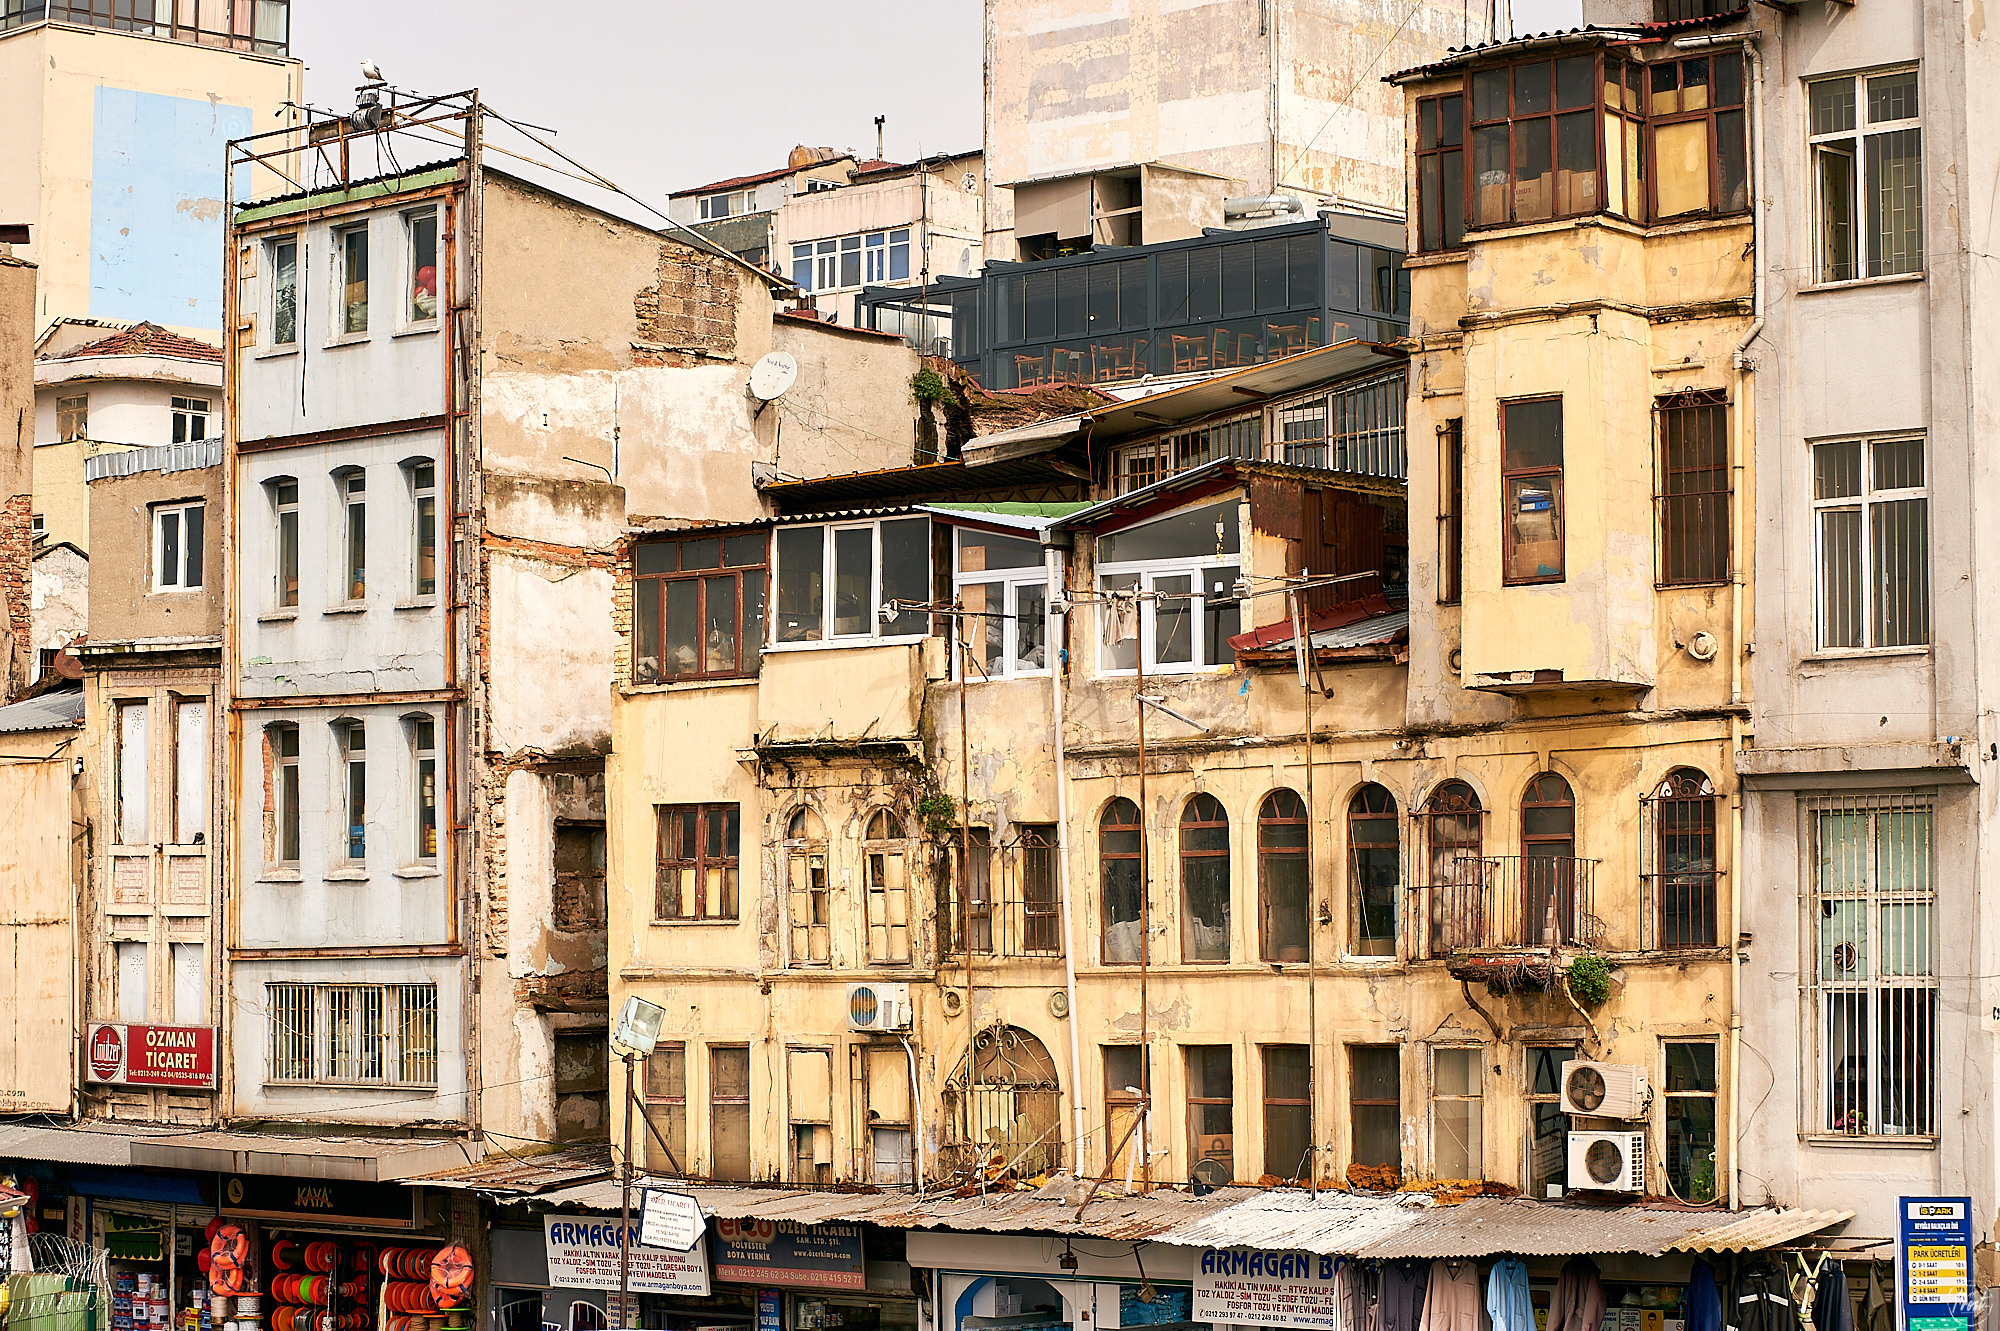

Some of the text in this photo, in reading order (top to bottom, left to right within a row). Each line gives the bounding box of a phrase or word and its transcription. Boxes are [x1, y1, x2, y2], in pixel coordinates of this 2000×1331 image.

[146, 1026, 196, 1048] ÖZMAN
[146, 1047, 197, 1069] TİCARET
[296, 1185, 332, 1208] KAYA
[731, 1241, 767, 1250] POLYESTER
[828, 1237, 841, 1247] ŞTİ.
[563, 1249, 582, 1258] HAKİKİ
[601, 1251, 620, 1259] VARAK
[642, 1253, 658, 1261] KALIP
[660, 1254, 686, 1263] SİLİKONU
[727, 1251, 770, 1261] BOYA VERNİK
[793, 1250, 851, 1259] www.özerkimya.com
[1930, 1249, 1960, 1257] ÜCRETLERİ
[597, 1260, 611, 1268] TOZU
[656, 1263, 686, 1272] FLORESAN
[687, 1265, 703, 1273] BOYA
[647, 1272, 676, 1280] MADDELER
[718, 1268, 737, 1276] Merk.
[738, 1268, 755, 1277] 0212
[757, 1269, 769, 1278] 245
[770, 1270, 779, 1279] 62
[780, 1271, 788, 1280] 34
[811, 1272, 827, 1282] 0216
[828, 1273, 842, 1282] 415
[843, 1274, 852, 1283] 52
[853, 1275, 862, 1284] 77
[632, 1280, 702, 1291] www.armaganboya.com
[1215, 1280, 1237, 1289] HAKİKİ
[1238, 1282, 1258, 1291] ALTIN
[1259, 1284, 1282, 1292] VARAK
[1289, 1285, 1307, 1294] RTV2
[1309, 1286, 1329, 1295] KALIP
[1197, 1289, 1210, 1298] TOZ
[1211, 1290, 1234, 1299] YALDIZ
[1278, 1294, 1298, 1303] SEDEF
[1227, 1301, 1333, 1315] FOSFOR TOZU VE KİMYEVİ MADDE
